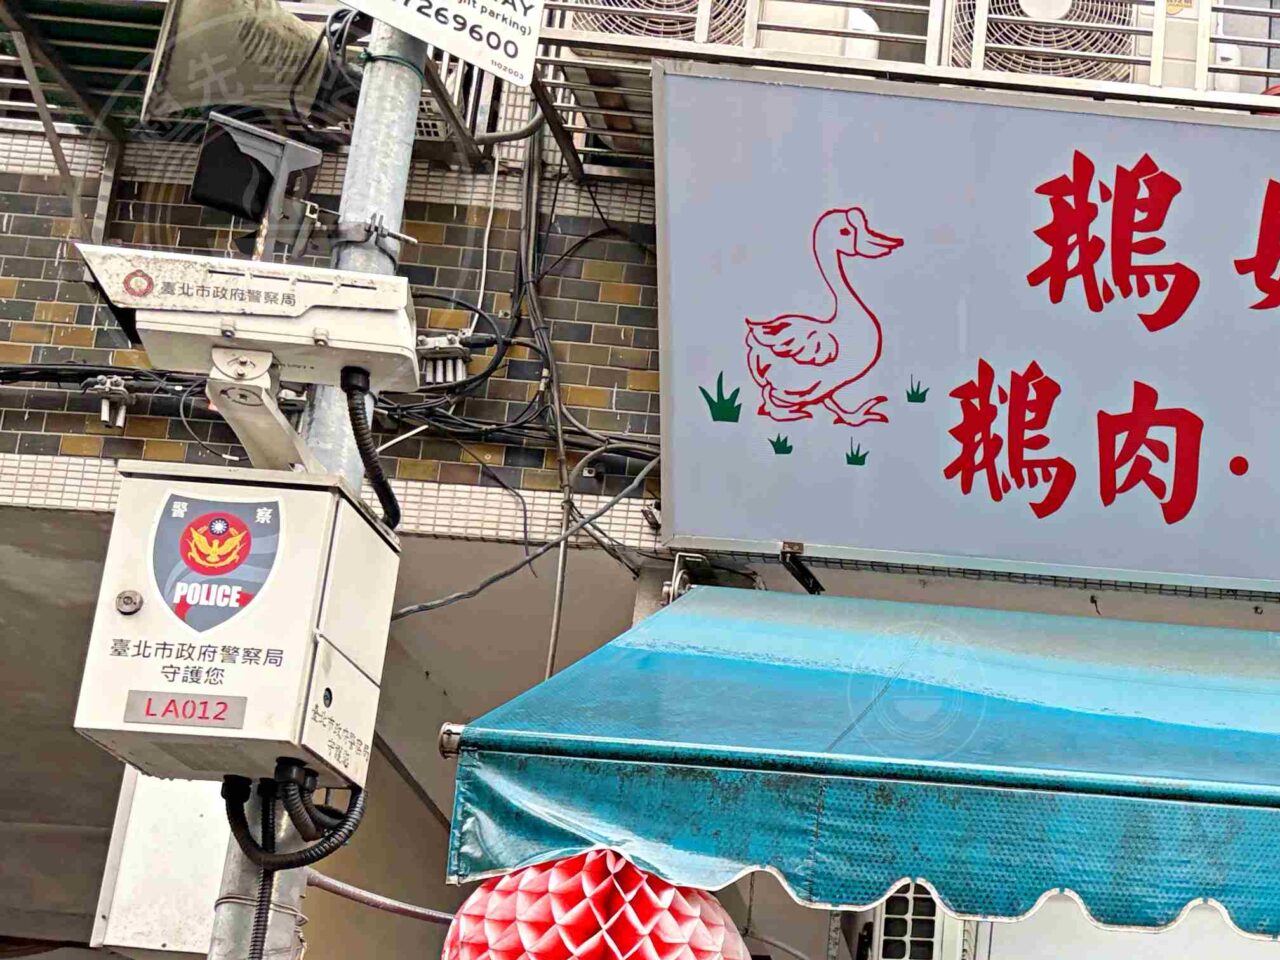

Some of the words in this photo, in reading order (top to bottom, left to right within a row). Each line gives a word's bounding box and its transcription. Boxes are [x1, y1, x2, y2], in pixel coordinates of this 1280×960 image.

[480, 5, 532, 36] parking)
[160, 281, 297, 307] 臺北市政府警察局
[171, 501, 188, 518] 警
[255, 507, 272, 524] 察
[173, 582, 242, 607] POLICE
[109, 638, 284, 668] 臺北市政府警察局
[160, 664, 226, 686] 守護您
[144, 697, 230, 721] LA012
